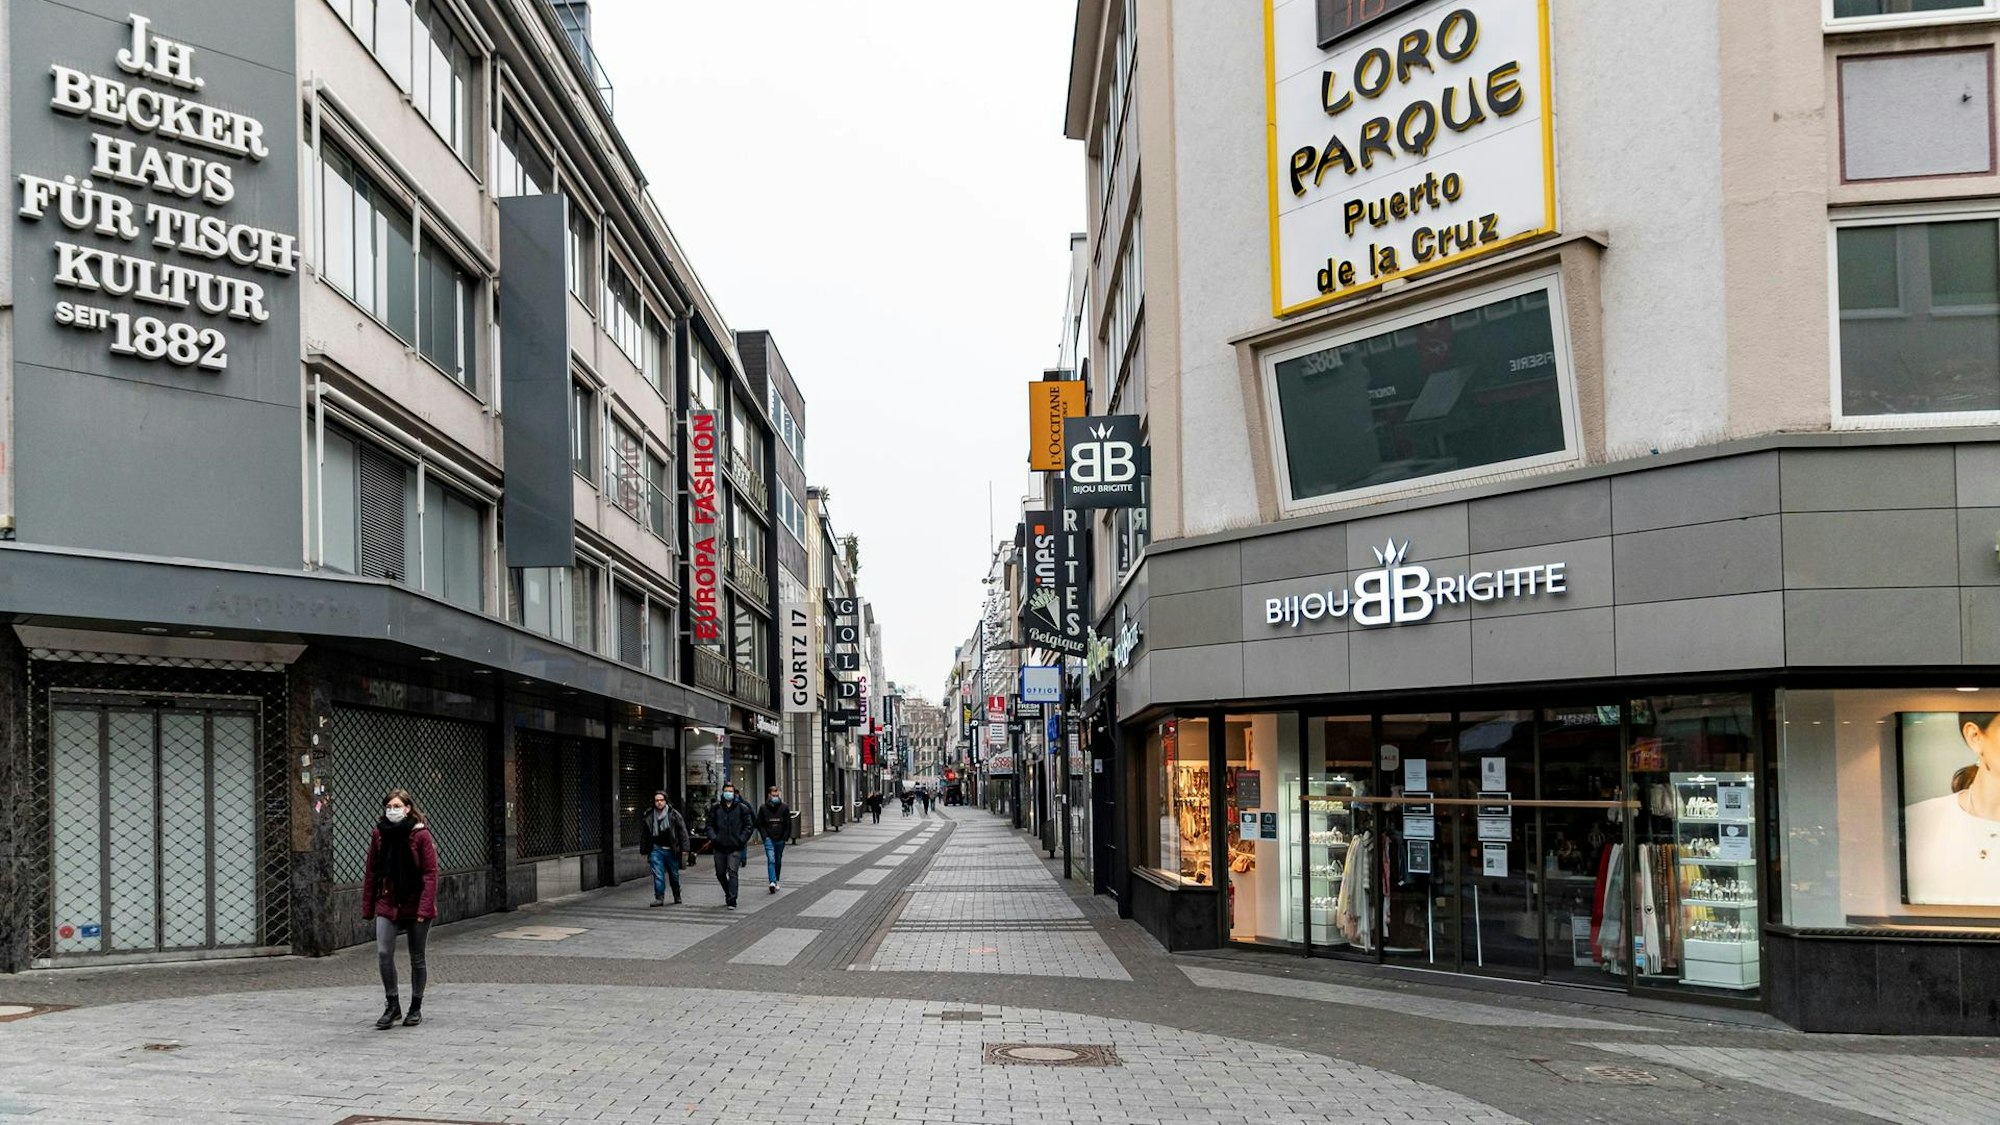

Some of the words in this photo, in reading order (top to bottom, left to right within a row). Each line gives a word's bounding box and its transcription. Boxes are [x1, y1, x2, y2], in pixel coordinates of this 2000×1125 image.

[115, 13, 205, 91] J.H.
[1321, 8, 1480, 115] LORO
[50, 64, 269, 161] BECKER
[1290, 60, 1524, 197] PARQUE
[19, 173, 139, 240] FÜR
[91, 133, 234, 205] HAUS
[1344, 171, 1464, 238] Puerto
[54, 241, 269, 323] KULTUR
[1317, 258, 1355, 294] de
[1369, 244, 1400, 277] la
[1411, 213, 1499, 264] Cruz
[55, 301, 111, 329] SEIT
[109, 312, 227, 370] 1882
[1048, 385, 1061, 466] L'OCCITANE
[694, 414, 715, 524] FASHION
[1073, 484, 1095, 495] BIJOU
[1098, 483, 1133, 493] BRIGITTE
[696, 537, 717, 639] EUROPA
[791, 610, 808, 627] 17
[1266, 589, 1349, 628] BIJOU
[840, 600, 856, 697] GOLD
[1028, 627, 1085, 652] Belgique
